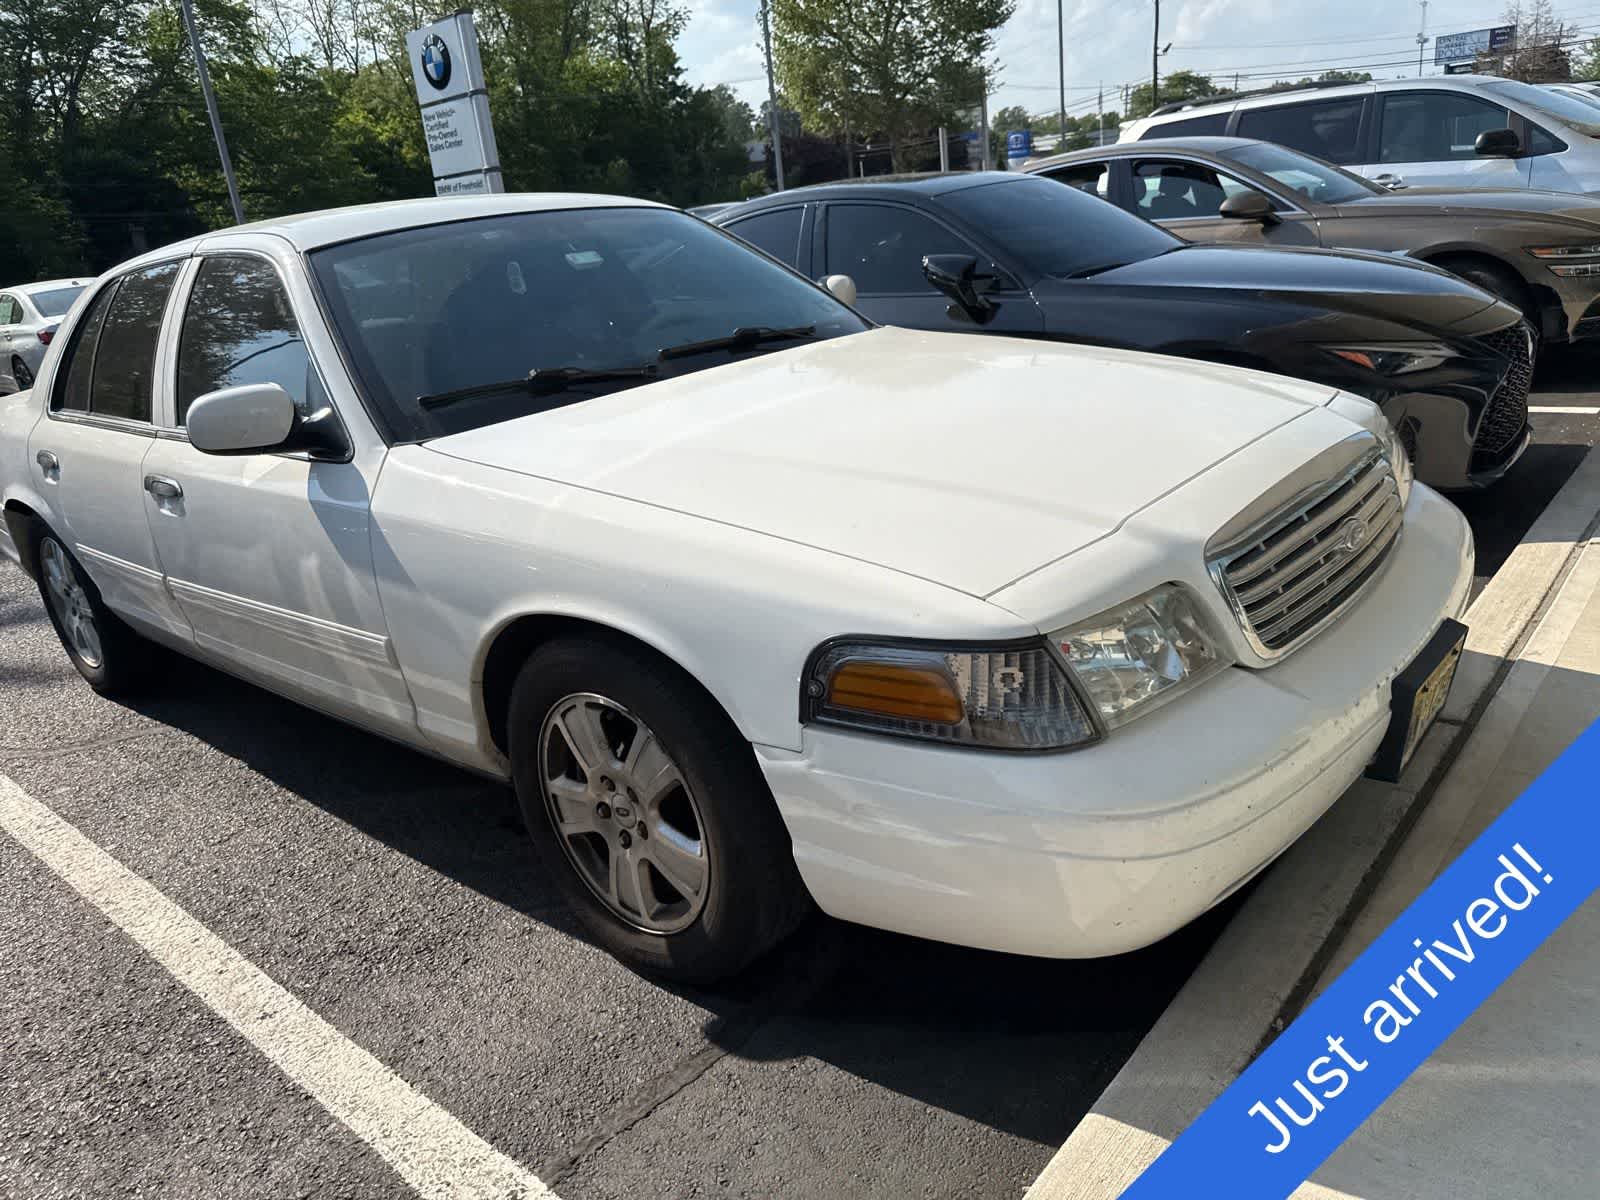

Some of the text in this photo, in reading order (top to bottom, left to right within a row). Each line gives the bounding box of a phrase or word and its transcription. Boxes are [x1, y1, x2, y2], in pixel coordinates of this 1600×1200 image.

[424, 112, 435, 121] New
[426, 121, 449, 131] Certified
[428, 129, 457, 142] Pre-Owned
[430, 139, 463, 152] Sales Center
[437, 180, 483, 194] BMW of Freehold
